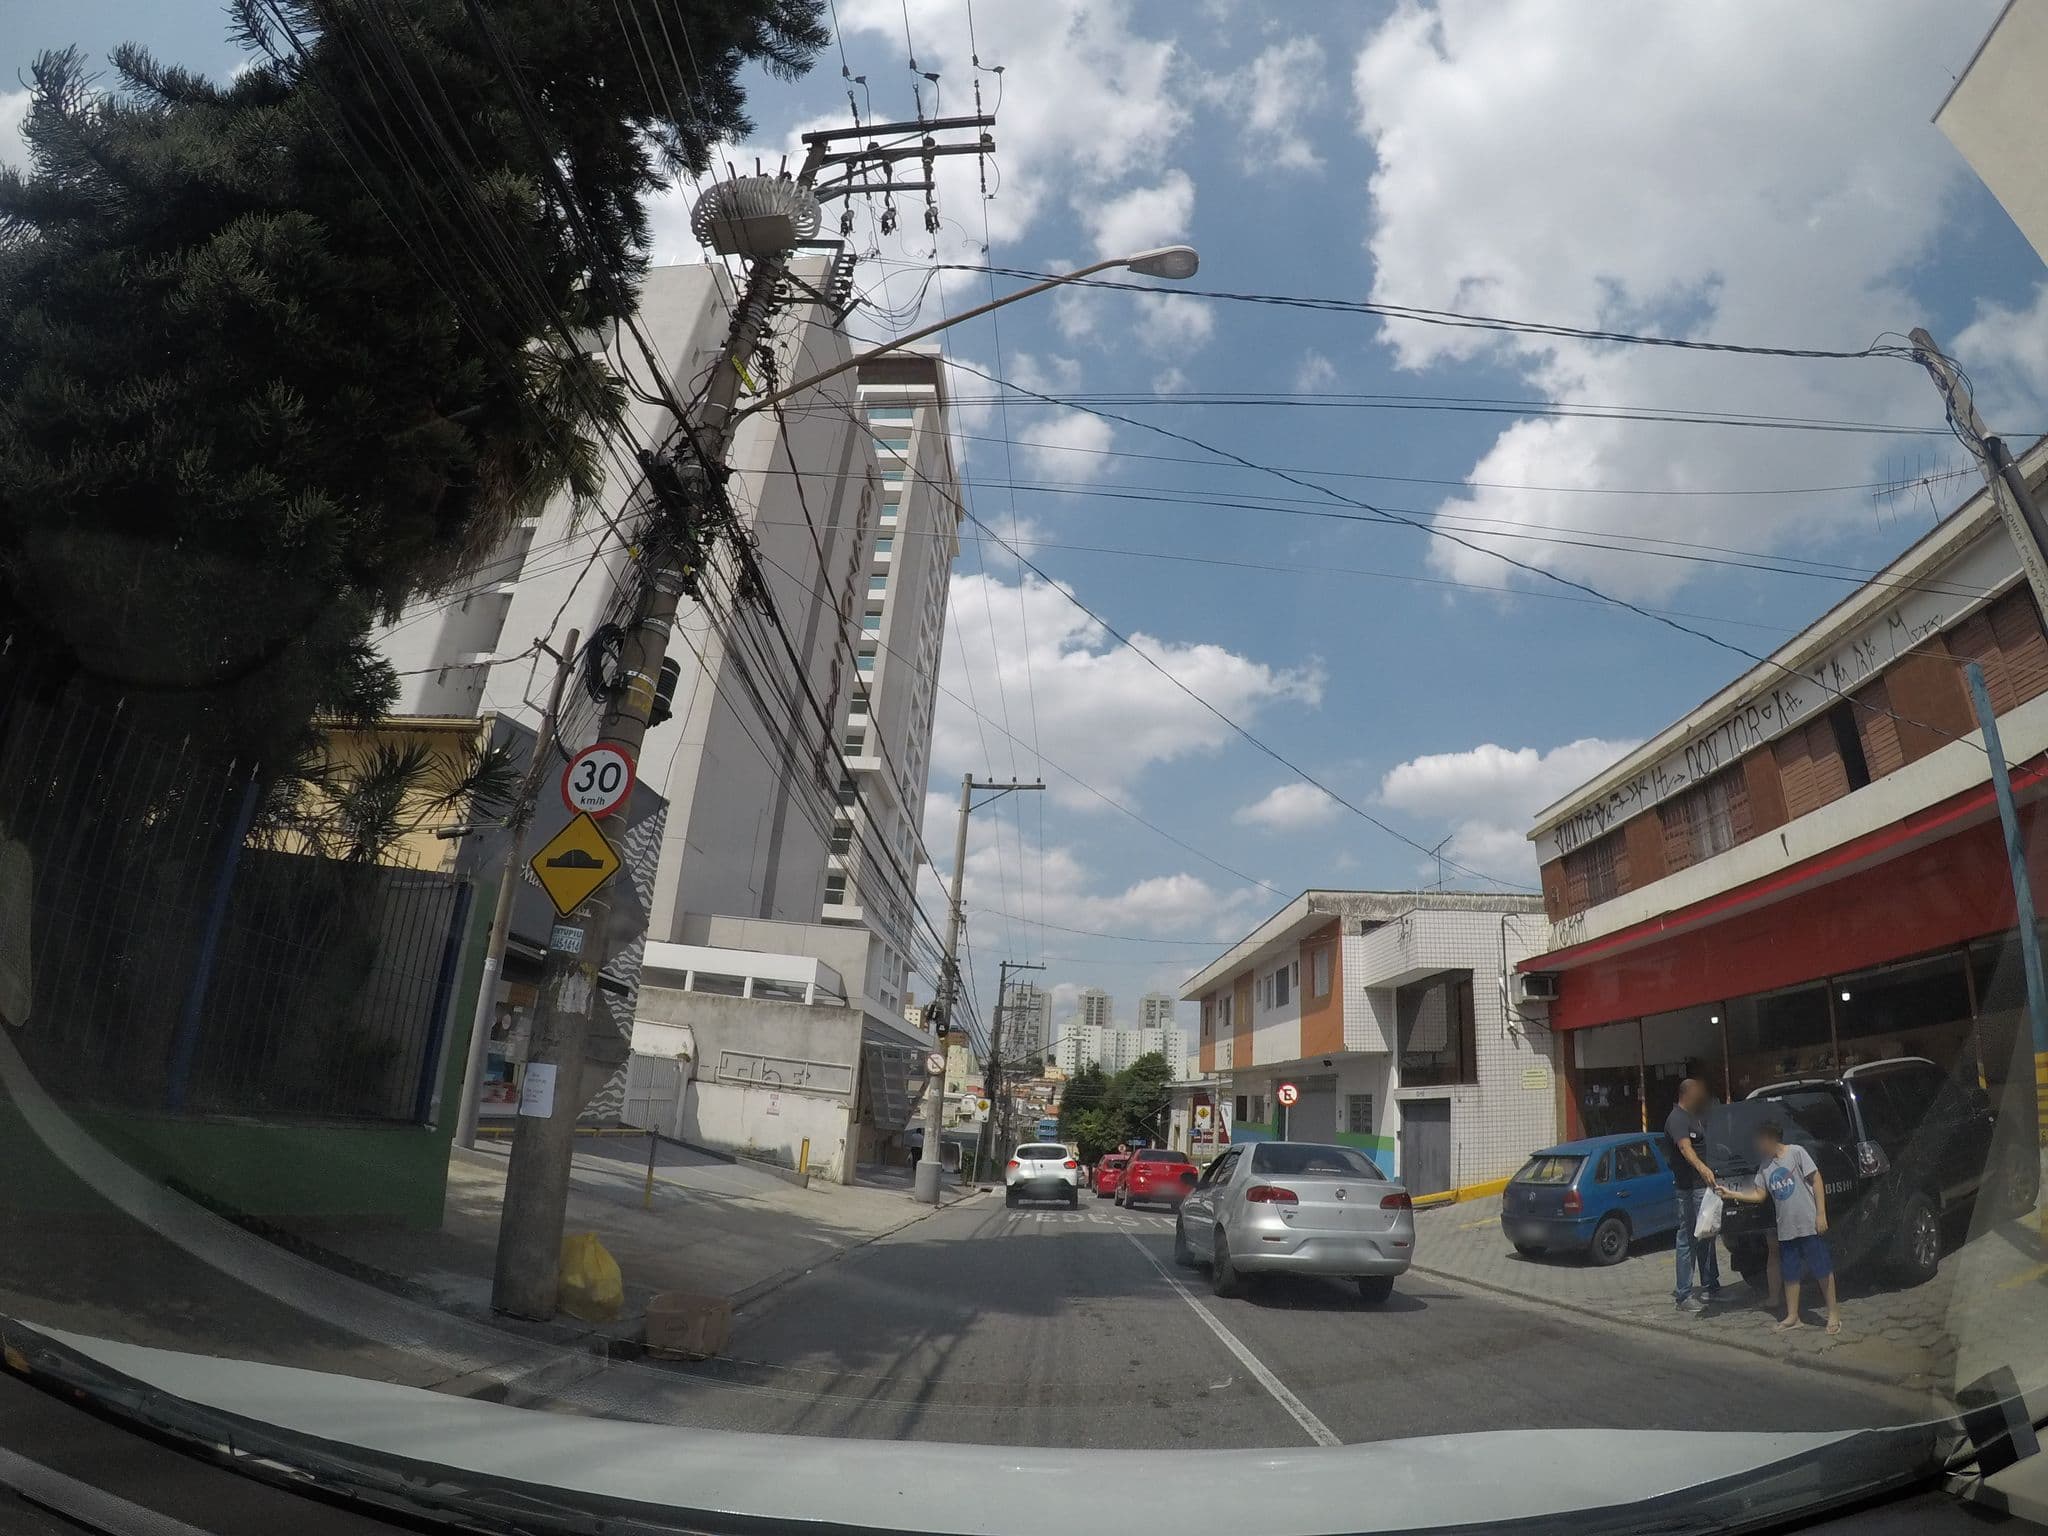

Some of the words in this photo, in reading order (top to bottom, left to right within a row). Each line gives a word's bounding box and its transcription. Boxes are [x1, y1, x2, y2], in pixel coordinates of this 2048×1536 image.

[574, 759, 621, 793] 30
[580, 796, 605, 805] km/h
[1771, 1177, 1794, 1191] NASA
[1825, 1181, 1852, 1194] BISHI
